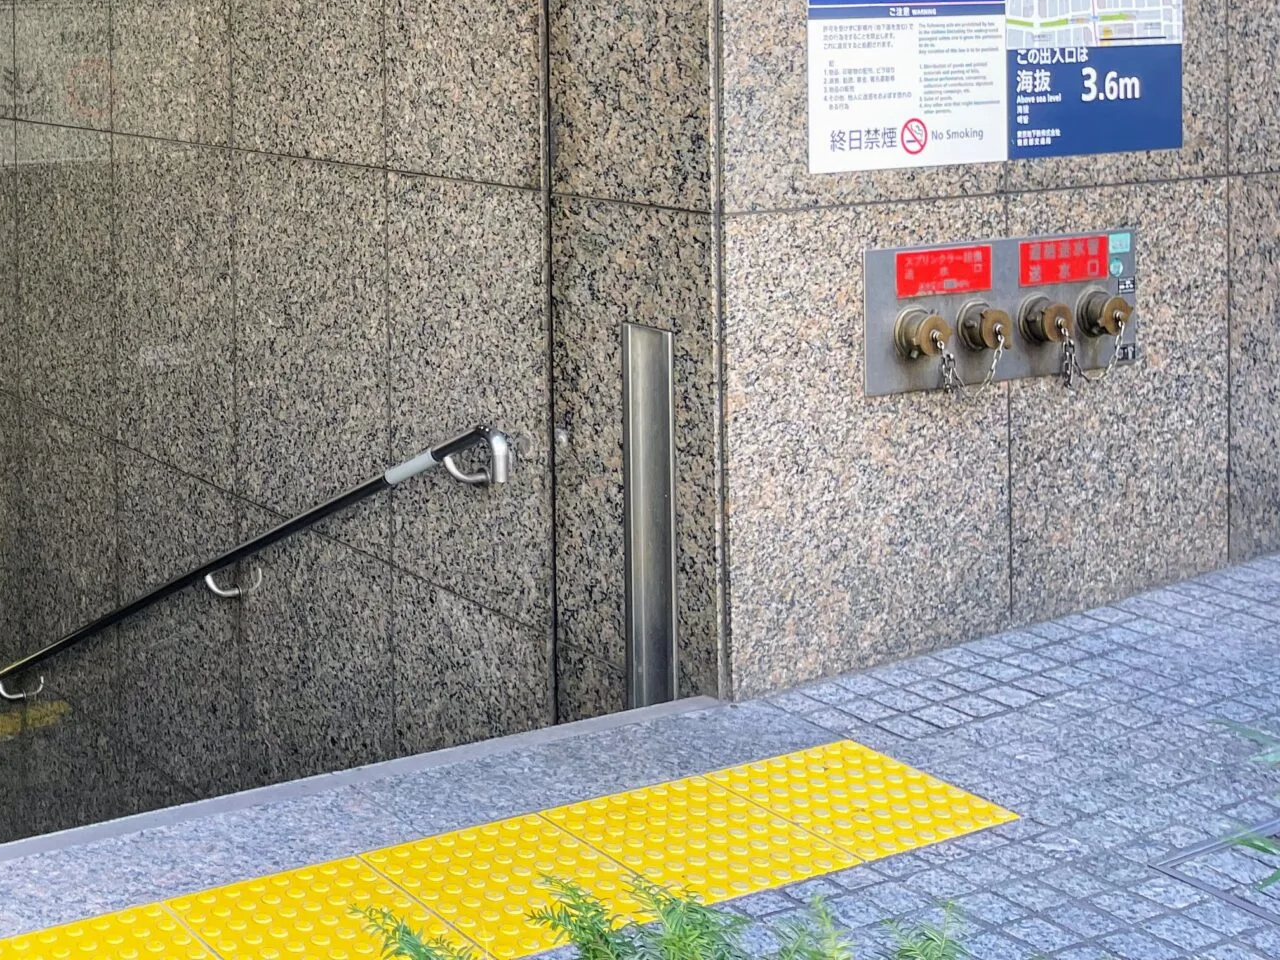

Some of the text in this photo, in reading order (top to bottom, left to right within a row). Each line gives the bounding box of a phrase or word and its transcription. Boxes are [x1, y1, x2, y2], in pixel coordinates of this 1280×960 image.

[1016, 47, 1089, 65] この出入口は
[1016, 69, 1051, 93] 海抜
[1081, 67, 1140, 102] 3.6m
[1016, 94, 1035, 104] Above
[1047, 92, 1062, 103] level
[829, 127, 984, 153] 終日禁煙 No Smoking
